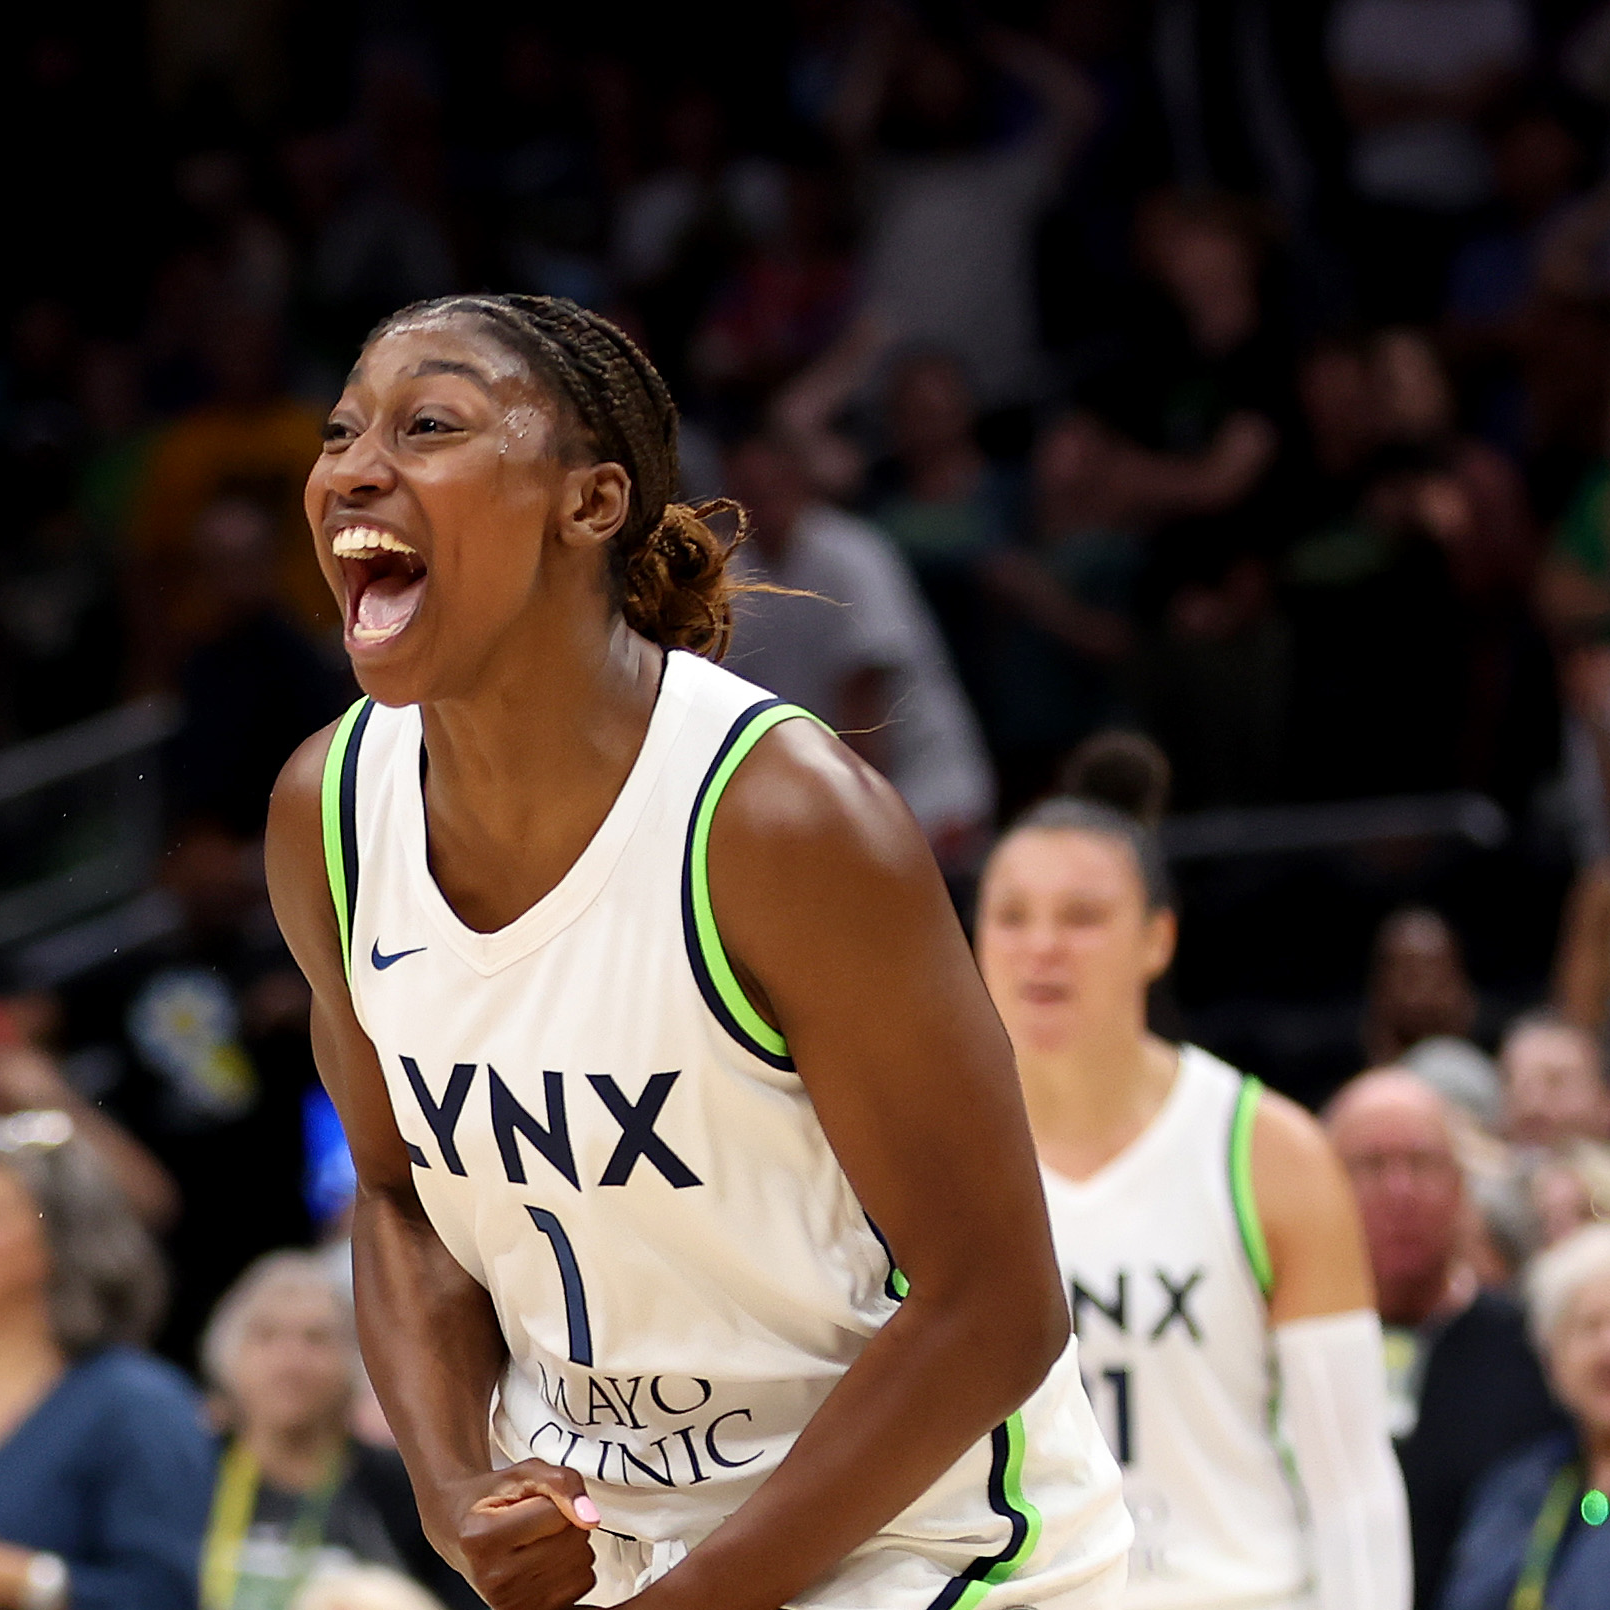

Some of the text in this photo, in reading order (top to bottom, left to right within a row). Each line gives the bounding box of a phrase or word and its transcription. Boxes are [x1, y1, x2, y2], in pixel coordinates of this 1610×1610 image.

[399, 1055, 704, 1192] YNX
[523, 1204, 594, 1368] 1
[1073, 1269, 1203, 1342] NX
[537, 1361, 712, 1430] MAYO
